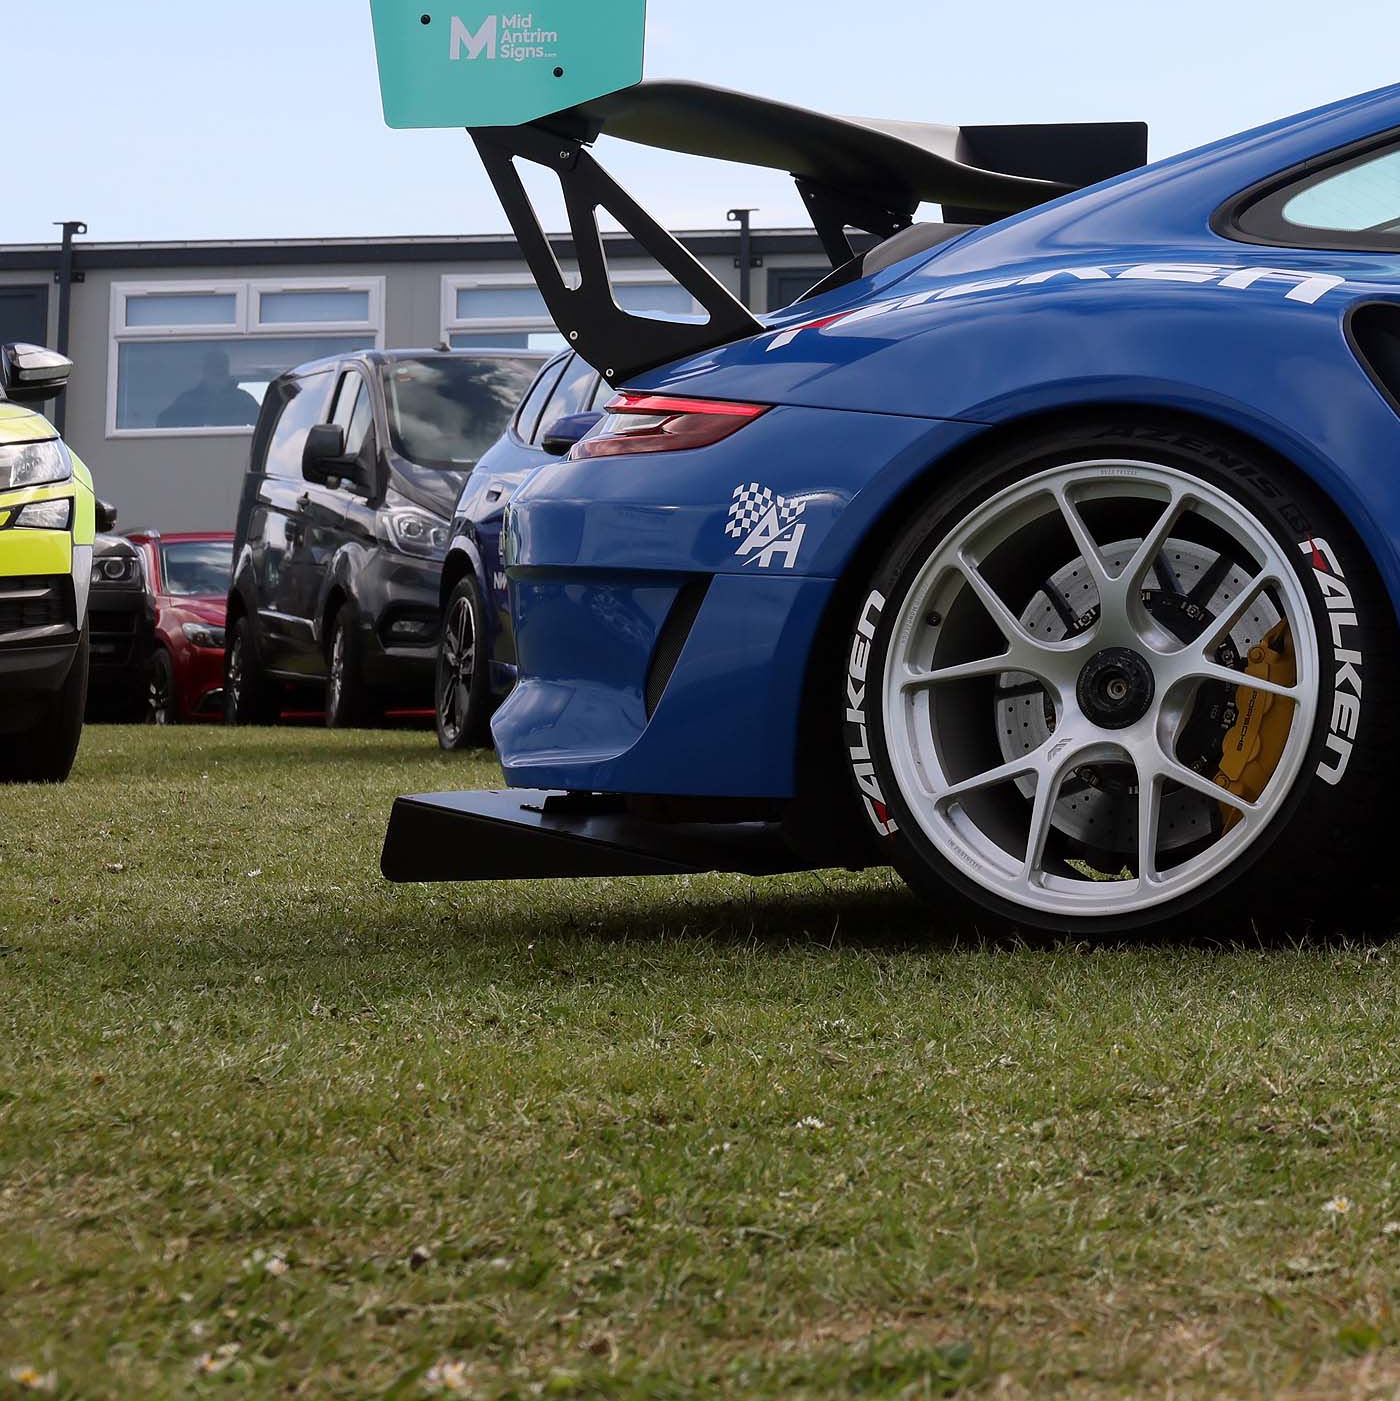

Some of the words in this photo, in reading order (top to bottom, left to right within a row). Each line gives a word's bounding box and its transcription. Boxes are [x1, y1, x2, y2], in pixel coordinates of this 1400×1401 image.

[501, 28, 558, 43] Antrim
[502, 14, 532, 29] Mid
[846, 589, 899, 838] FALKEN
[1298, 535, 1362, 786] FALKEN
